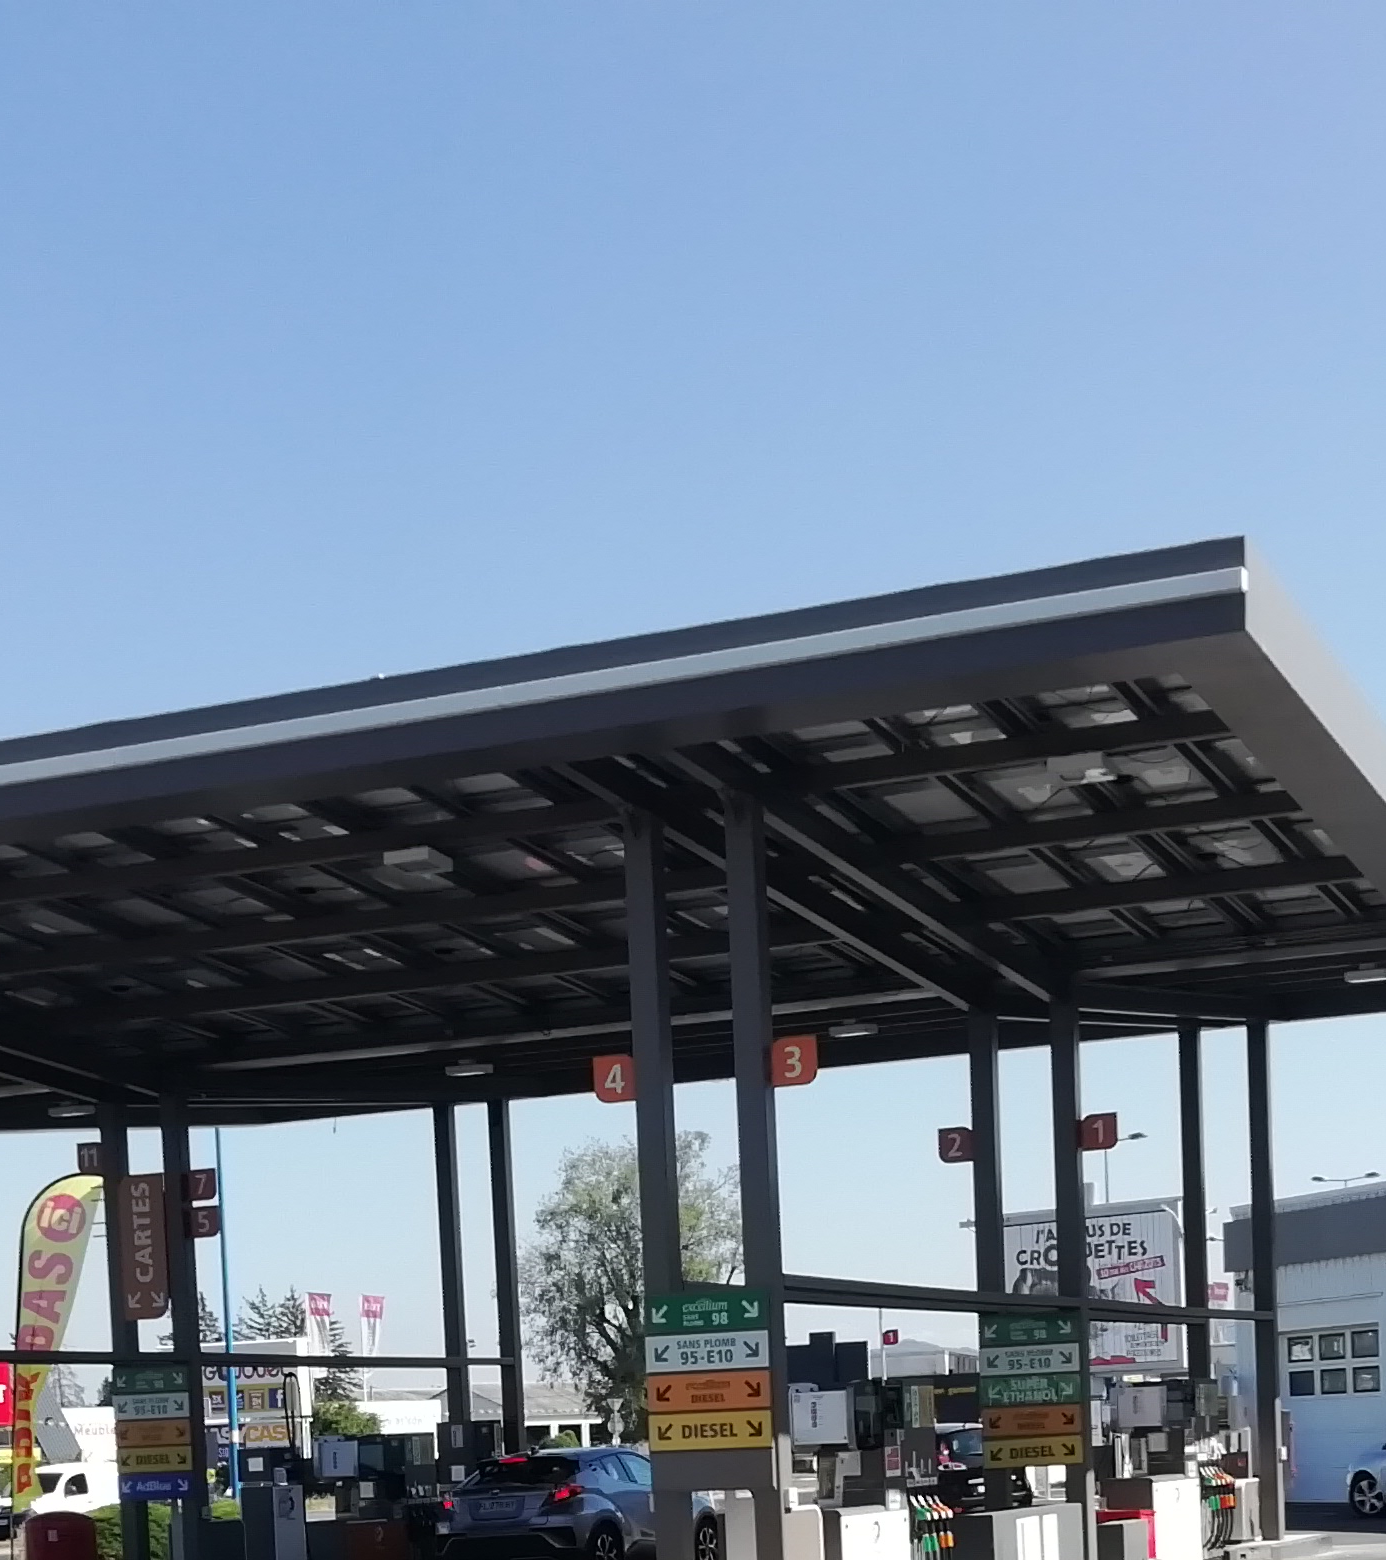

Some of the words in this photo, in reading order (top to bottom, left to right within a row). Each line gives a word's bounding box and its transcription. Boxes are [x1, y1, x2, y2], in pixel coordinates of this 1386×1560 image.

[783, 1045, 803, 1079] 3
[603, 1063, 625, 1095] 4
[1091, 1119, 1104, 1144] 1
[946, 1132, 963, 1158] 2
[194, 1174, 208, 1194] 7
[198, 1210, 210, 1232] 5
[1110, 1222, 1132, 1236] DE
[130, 1181, 153, 1284] CARTES
[711, 1312, 729, 1325] 98
[676, 1340, 701, 1350] SANS
[704, 1338, 737, 1349] PLOMB
[681, 1422, 738, 1439] DIESEL
[1009, 1445, 1056, 1460] DIESEL
